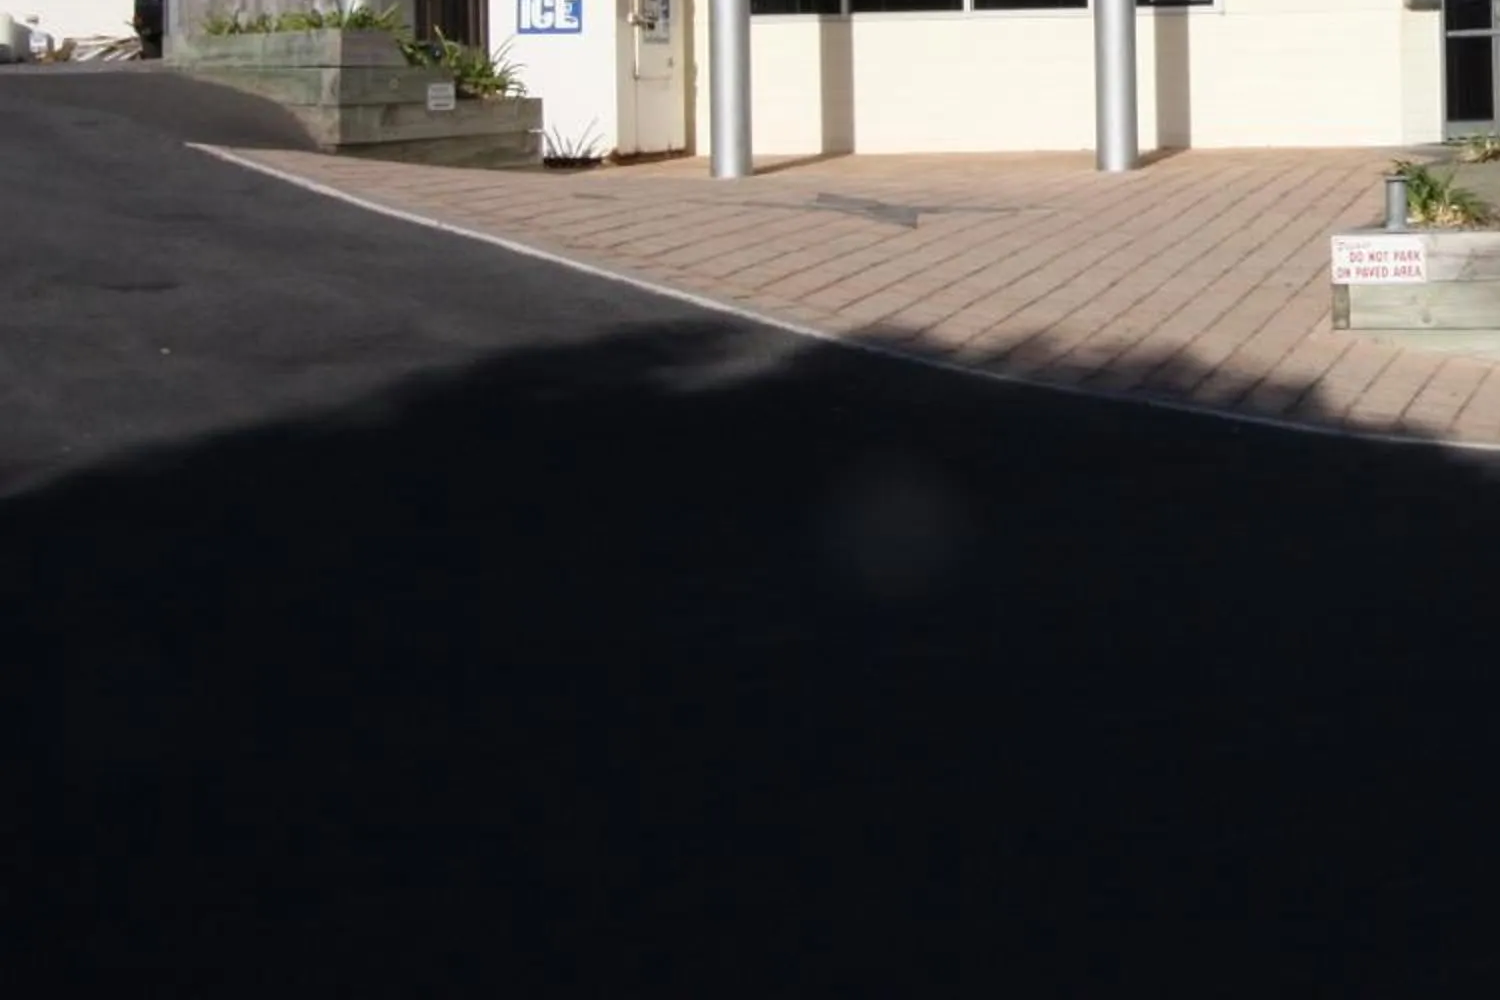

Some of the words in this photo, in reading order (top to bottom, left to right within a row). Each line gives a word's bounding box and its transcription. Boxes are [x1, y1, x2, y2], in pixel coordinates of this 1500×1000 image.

[1349, 250, 1364, 263] DO
[1368, 250, 1389, 263] NOT
[1393, 248, 1421, 262] PARK
[1336, 265, 1351, 279] ON
[1355, 265, 1389, 279] PAVED
[1393, 264, 1422, 278] AREA
